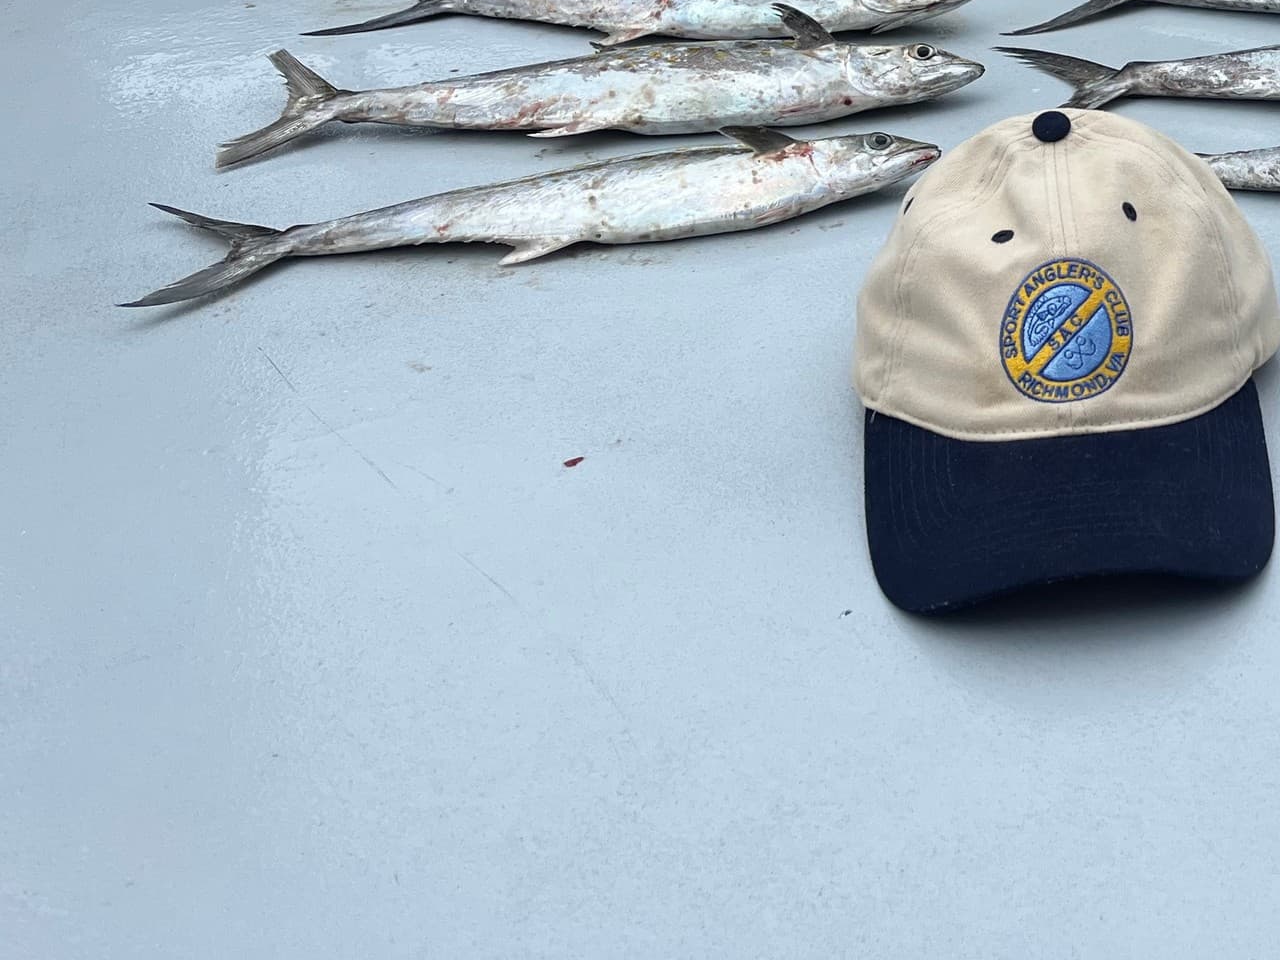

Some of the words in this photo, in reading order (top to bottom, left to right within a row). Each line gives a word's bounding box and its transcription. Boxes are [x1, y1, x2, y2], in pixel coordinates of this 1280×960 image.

[1003, 299, 1025, 359] SPORT
[1024, 263, 1105, 298] ANGLER'S
[1105, 290, 1130, 337] CLUB
[1105, 351, 1126, 373] VA
